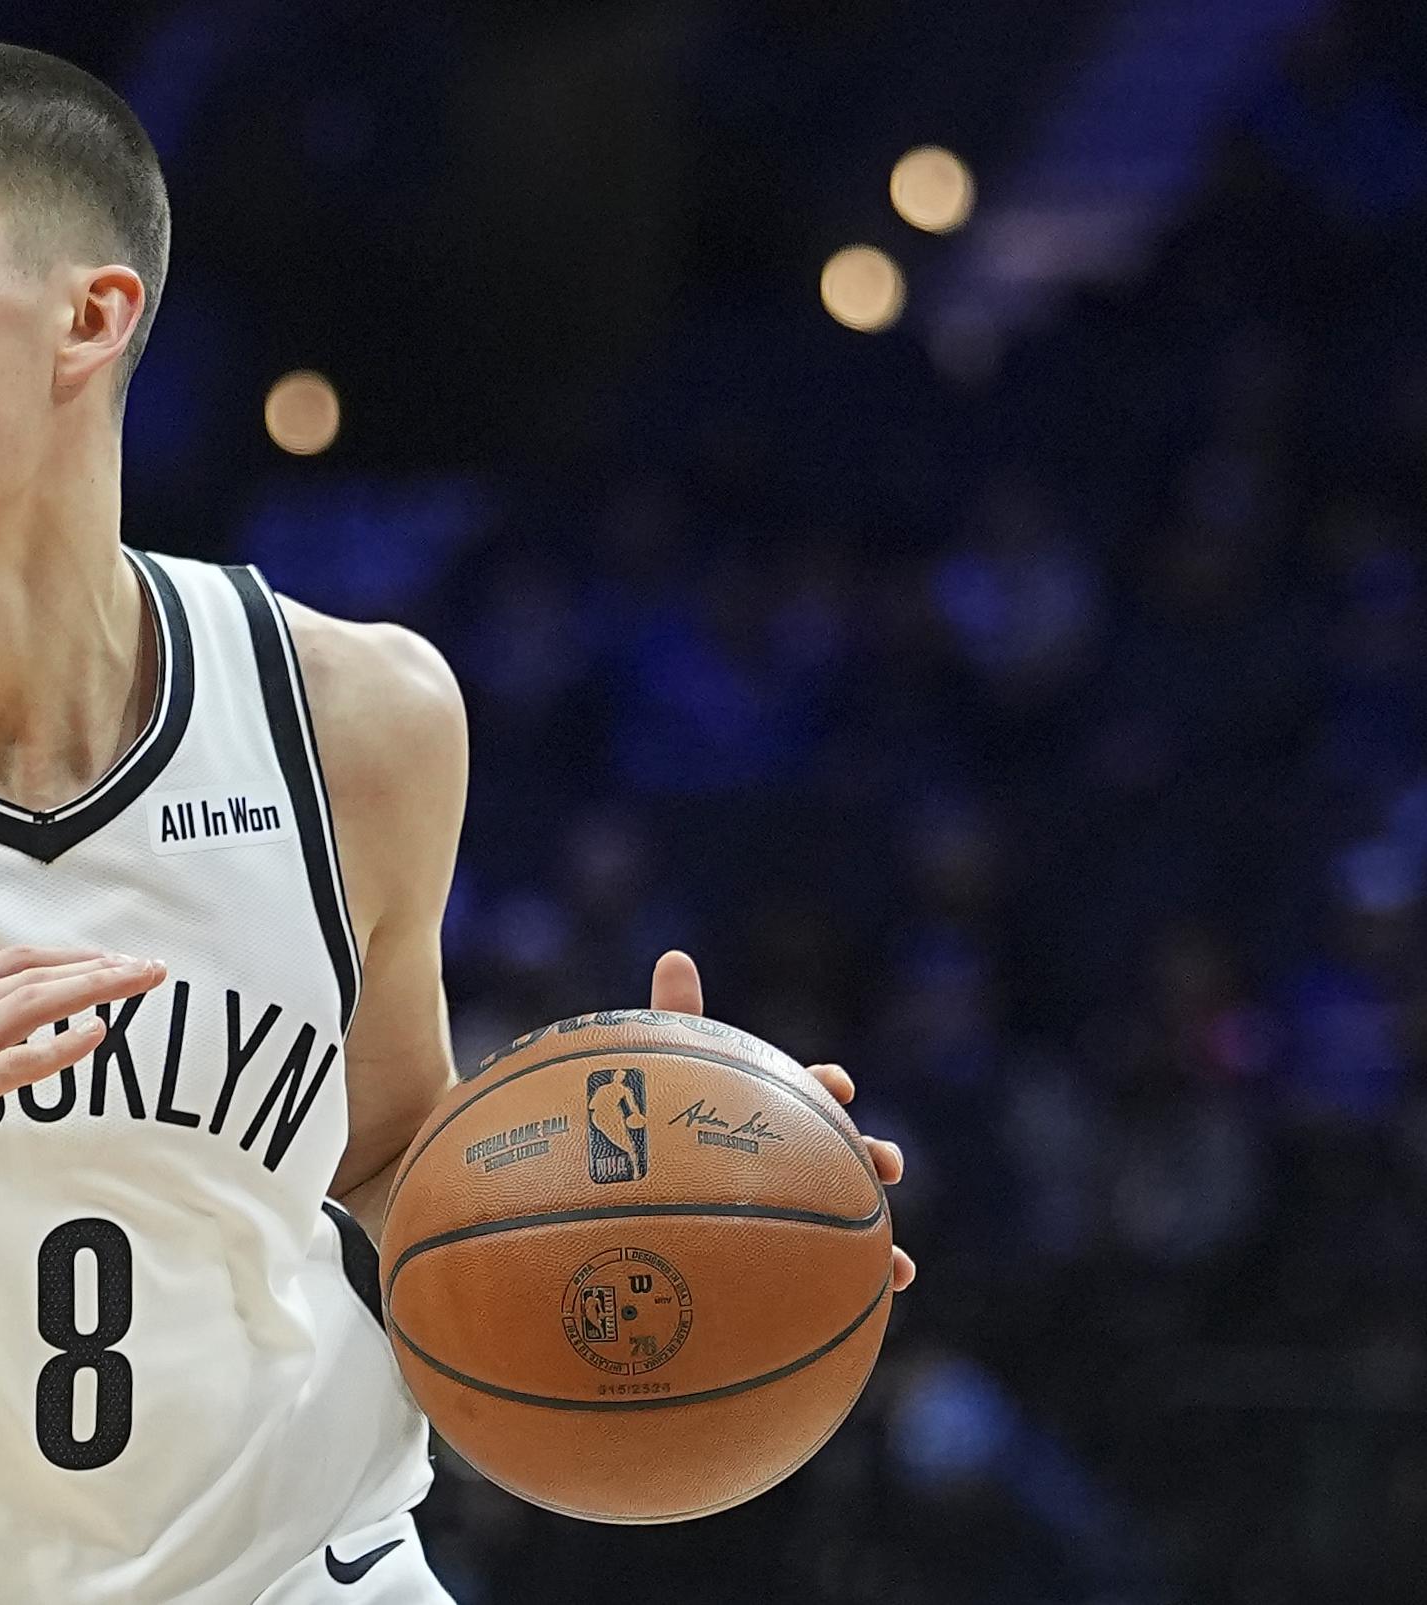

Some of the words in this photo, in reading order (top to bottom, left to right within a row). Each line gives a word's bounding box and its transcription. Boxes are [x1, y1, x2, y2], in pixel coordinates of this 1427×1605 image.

[161, 802, 196, 843] All
[201, 800, 228, 837] In
[228, 796, 281, 834] Won
[35, 1217, 133, 1471] 8
